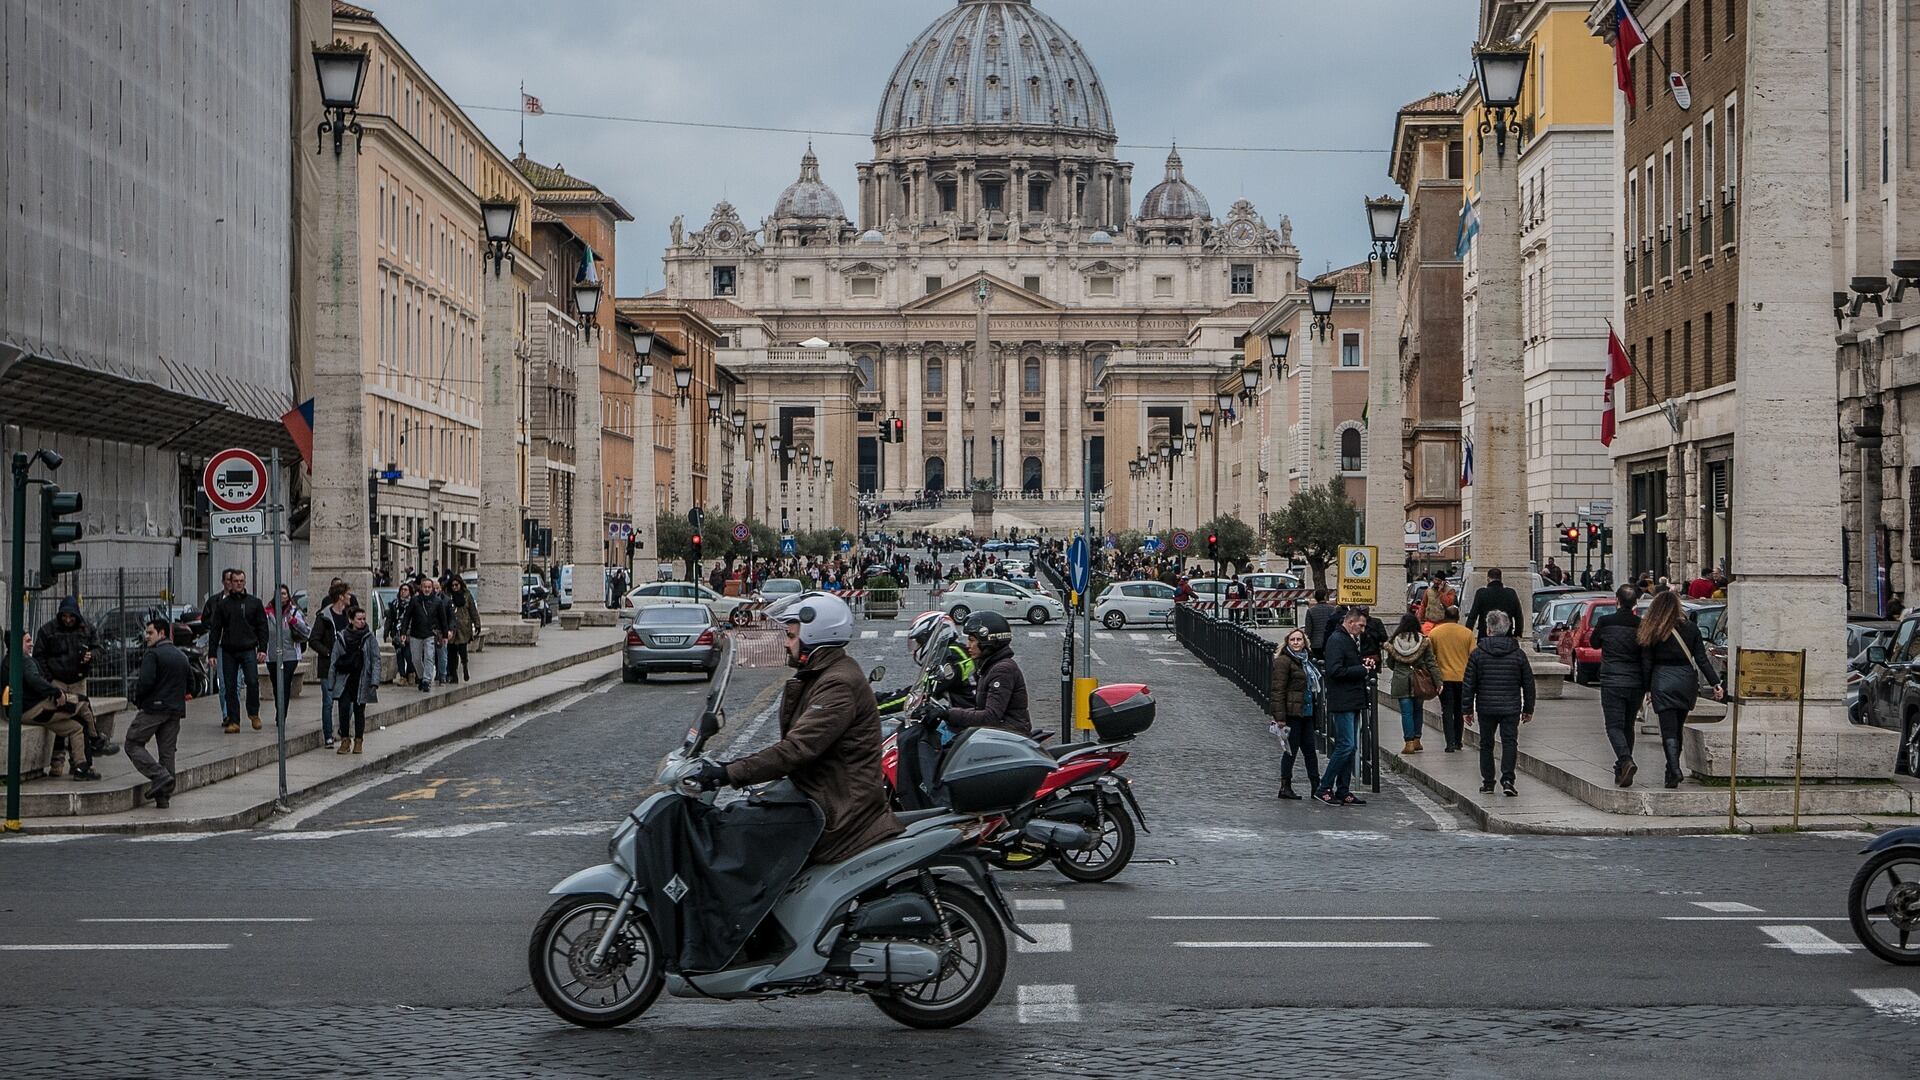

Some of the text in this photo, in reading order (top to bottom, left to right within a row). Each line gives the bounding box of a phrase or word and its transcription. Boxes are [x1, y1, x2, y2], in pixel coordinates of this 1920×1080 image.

[777, 321, 827, 329] HONOREM
[828, 321, 877, 329] PRINCIPIS
[908, 320, 940, 329] PAVLVS
[1010, 320, 1059, 328] ROMANVS
[228, 488, 234, 498] 6
[219, 514, 256, 524] eccetto
[227, 525, 249, 533] atac
